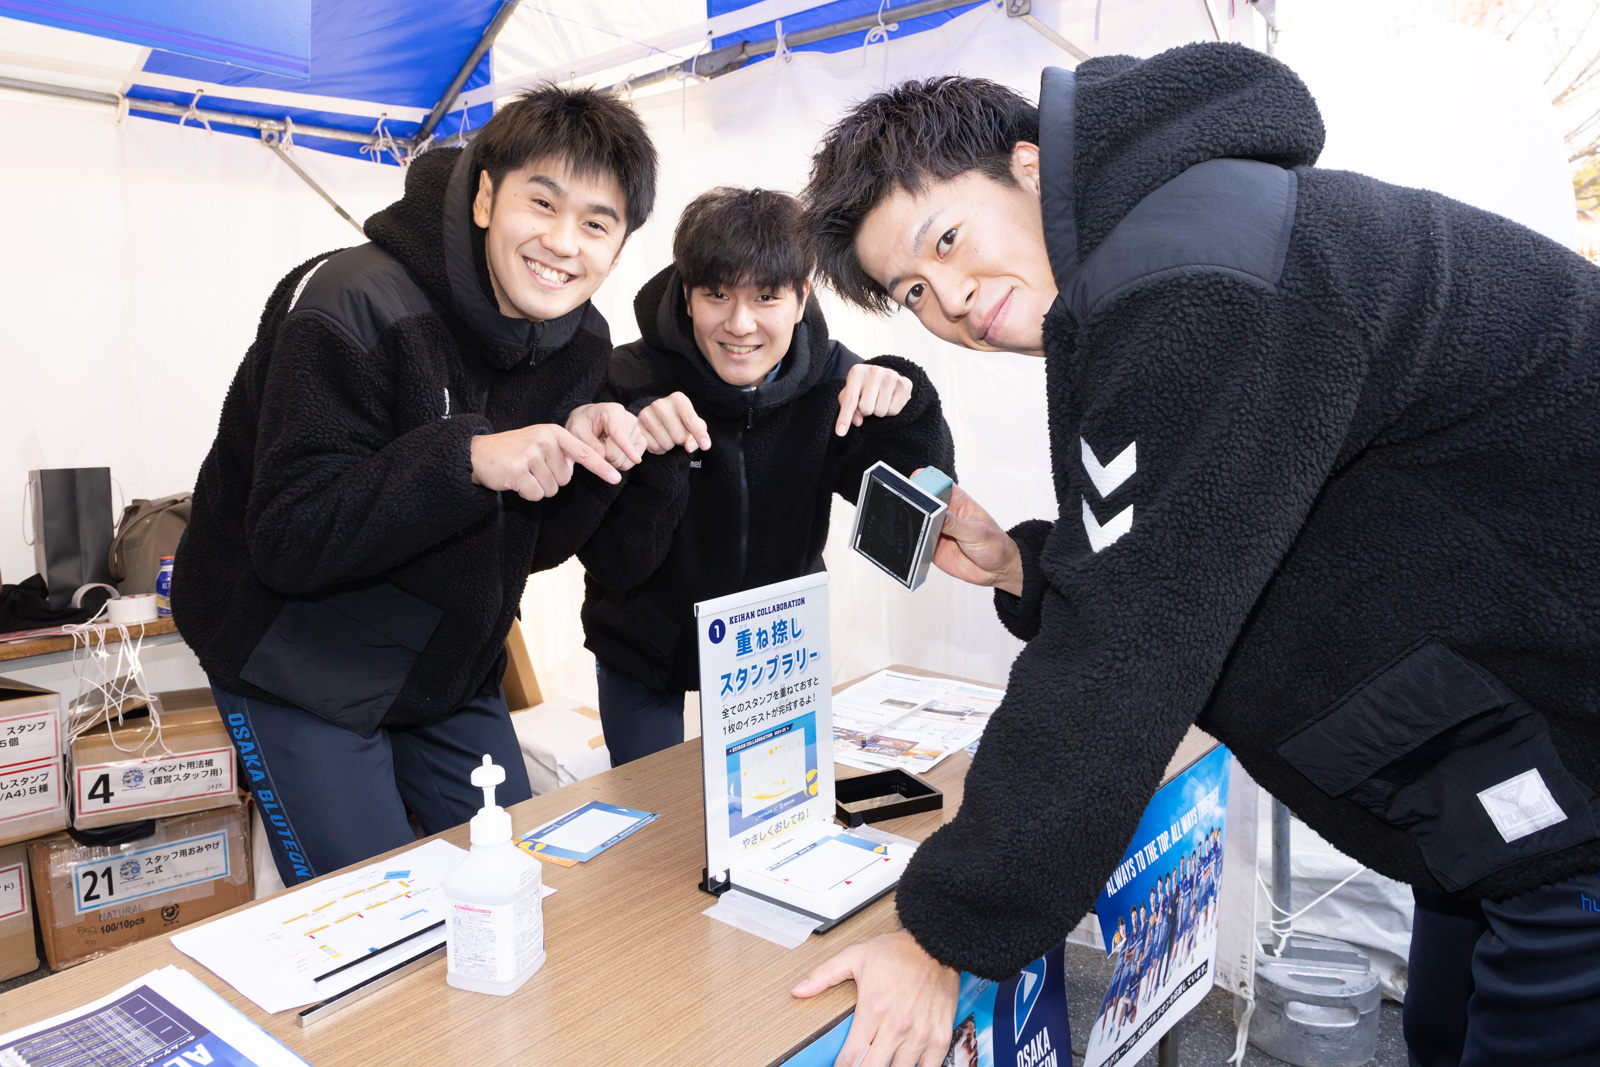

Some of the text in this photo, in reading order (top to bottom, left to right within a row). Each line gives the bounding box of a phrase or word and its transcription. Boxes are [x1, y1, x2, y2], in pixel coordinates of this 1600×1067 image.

[729, 597, 805, 625] KEIHAN COLLABORATION
[735, 617, 802, 657] 重ね捺し
[720, 648, 818, 697] スタンプラリー
[722, 676, 819, 719] 全てのスタンプを重ねておすと
[7, 721, 47, 736] スタンプ
[149, 758, 214, 775] イベント用法被
[88, 773, 114, 804] 4
[228, 712, 266, 783] OSAKA
[257, 789, 312, 878] BLUTEON
[742, 808, 809, 849] やさしくおしてね！
[145, 841, 220, 866] スタッフ用おみやげ
[145, 865, 163, 875] 一式
[1105, 857, 1137, 898] ALWAYS
[1134, 850, 1147, 873] TO
[1143, 840, 1160, 866] THE
[1170, 821, 1183, 845] ALL
[1180, 806, 1198, 835] WAYS
[82, 866, 114, 902] 21
[99, 904, 144, 922] NATURAL
[1016, 1026, 1051, 1067] OSAKA
